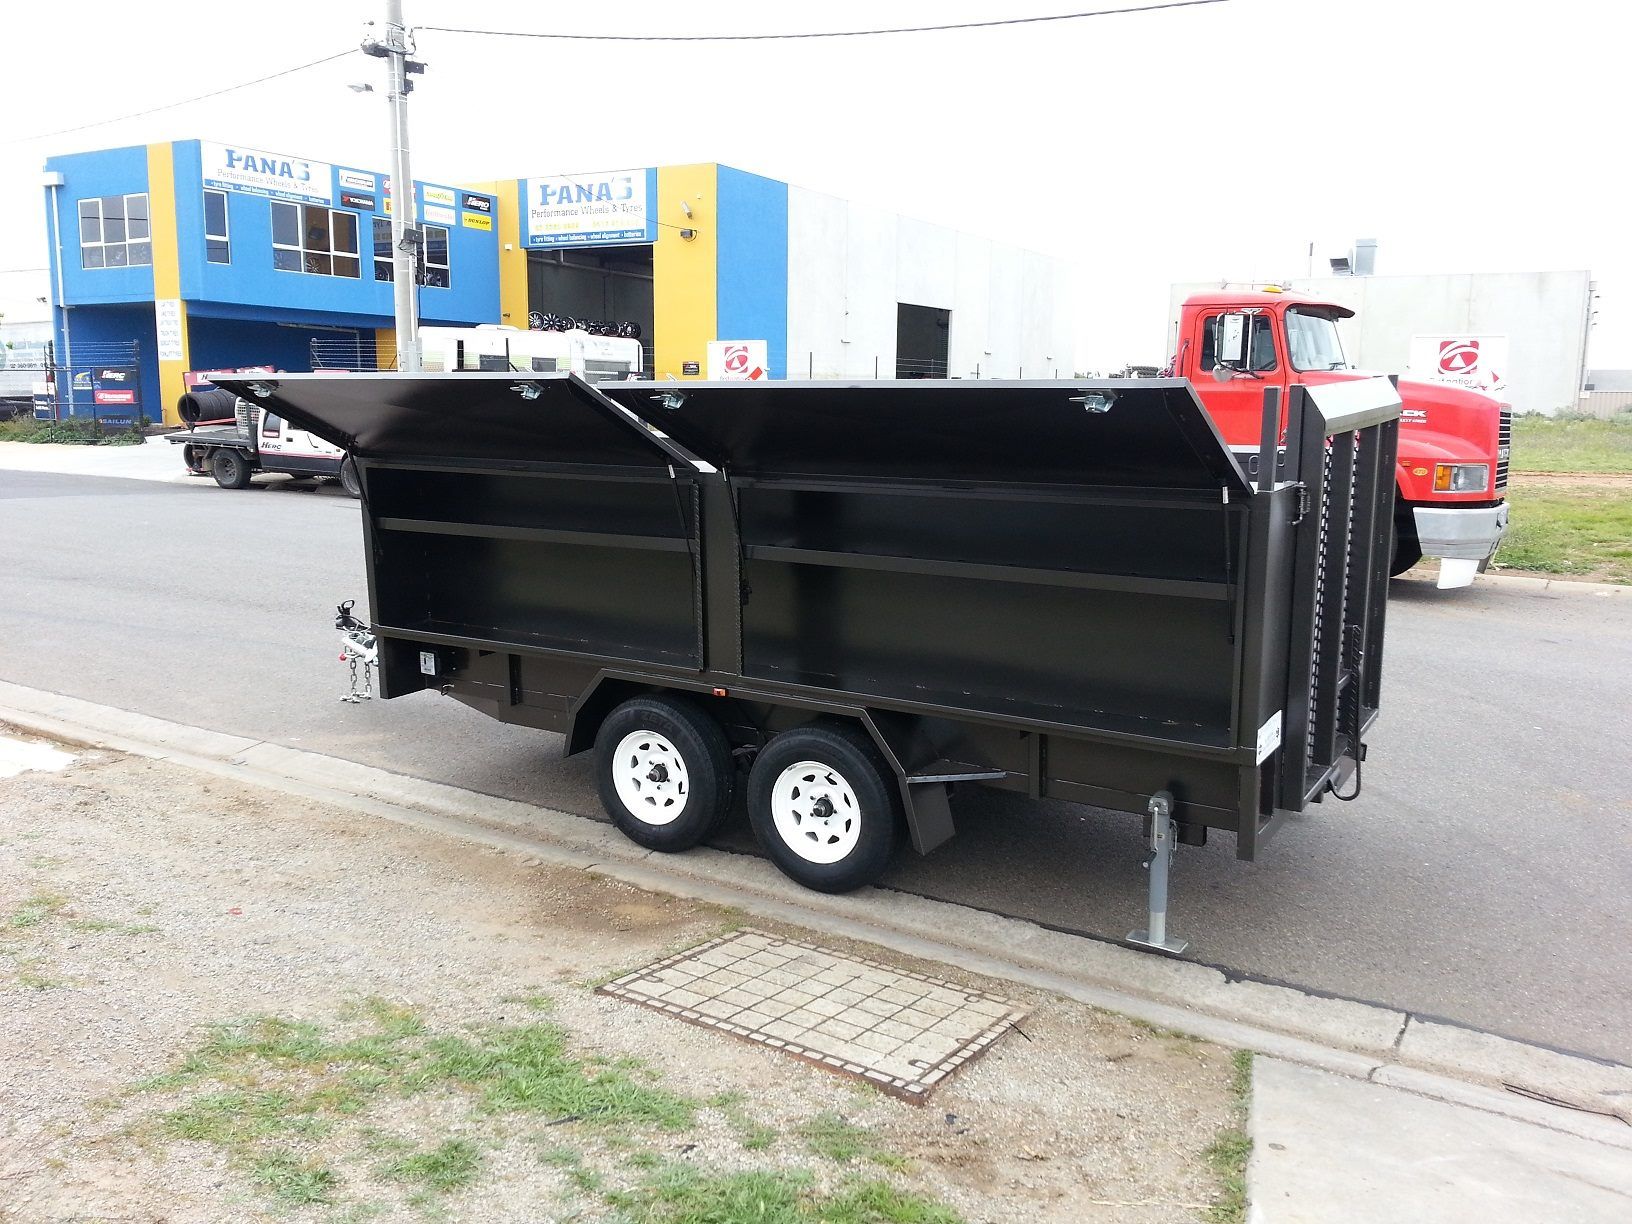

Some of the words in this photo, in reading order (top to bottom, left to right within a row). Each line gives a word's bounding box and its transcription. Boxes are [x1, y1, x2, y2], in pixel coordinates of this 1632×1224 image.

[225, 148, 310, 181] PANA'S
[217, 168, 264, 184] Performance
[265, 176, 291, 189] Wheels
[539, 176, 633, 206] PANA'S
[531, 208, 579, 219] Performance
[581, 205, 610, 215] Wheels
[620, 203, 643, 213] Tyres
